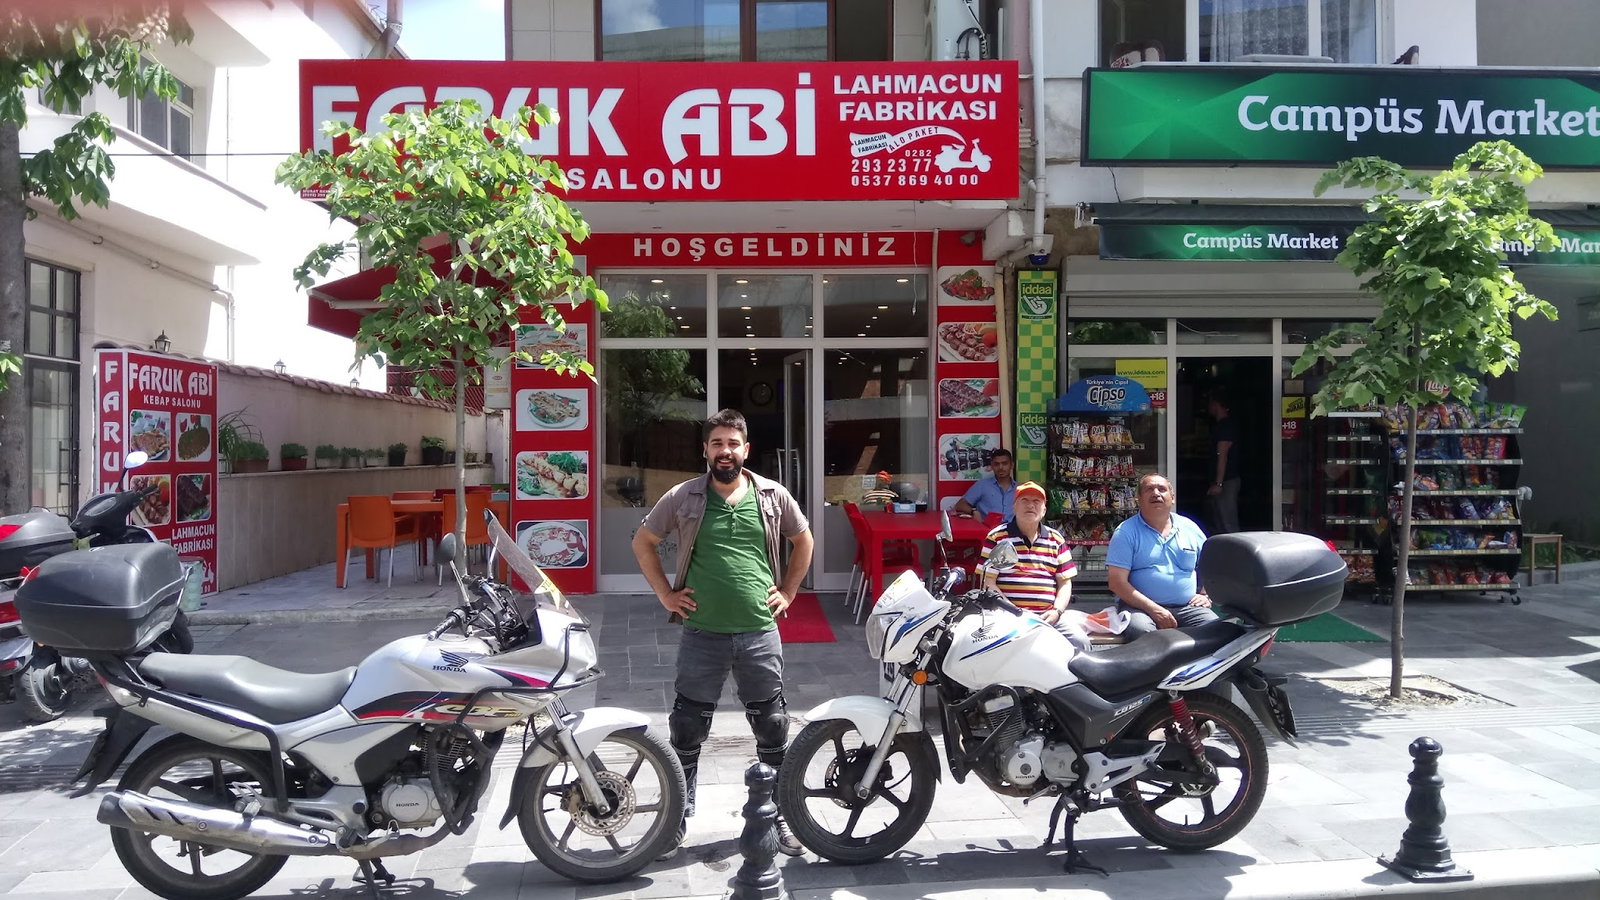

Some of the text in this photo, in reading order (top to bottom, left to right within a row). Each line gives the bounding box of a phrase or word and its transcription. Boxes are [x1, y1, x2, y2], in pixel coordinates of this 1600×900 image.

[834, 74, 1002, 95] LAHMACUN
[839, 97, 997, 122] FABRİKASI
[661, 72, 816, 166] ABİ
[1237, 95, 1600, 142] Campüs Market
[854, 133, 887, 146] LAHMACUN
[857, 141, 889, 153] FABRİKASI
[888, 126, 940, 152] ALO PAKET
[905, 149, 932, 157] 0282
[851, 158, 932, 173] 293 23 77
[566, 168, 722, 190] SALONU
[851, 174, 979, 187] 0537 869 40 00
[633, 233, 896, 262] HOŞGELDİNİZ
[1183, 232, 1339, 252] Campüs Market
[1022, 284, 1052, 295] iddaa
[128, 362, 213, 397] FARUK ABİ
[143, 394, 201, 409] KEBAP SALONU
[1087, 385, 1127, 406] Cipso
[1149, 392, 1165, 401] +18
[1282, 421, 1297, 430] +18
[172, 524, 215, 540] LAHMACUN
[173, 538, 214, 554] FABRİKASI
[972, 634, 999, 643] HONDA
[432, 665, 467, 673] HONDA
